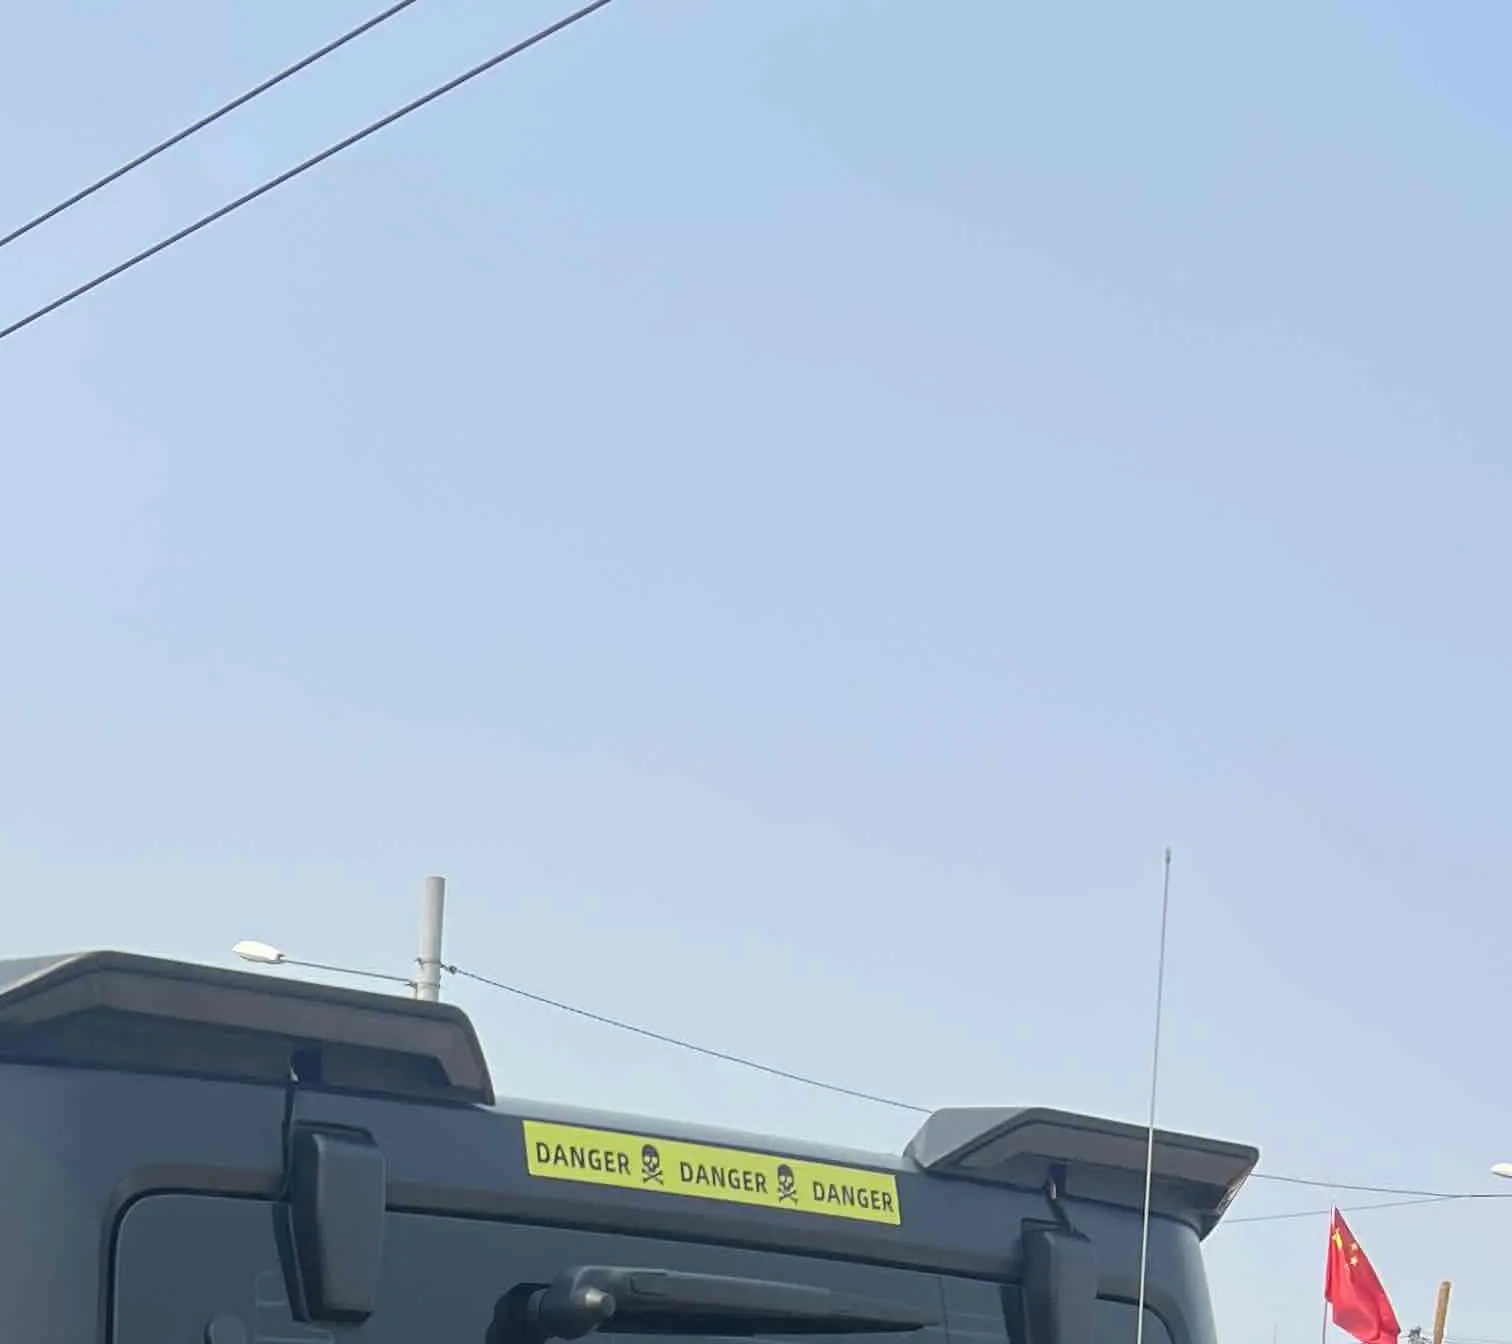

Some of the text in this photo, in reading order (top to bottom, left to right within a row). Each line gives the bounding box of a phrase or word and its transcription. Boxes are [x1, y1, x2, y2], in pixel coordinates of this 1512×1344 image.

[535, 1141, 895, 1214] DANGER DANGER DANGER
